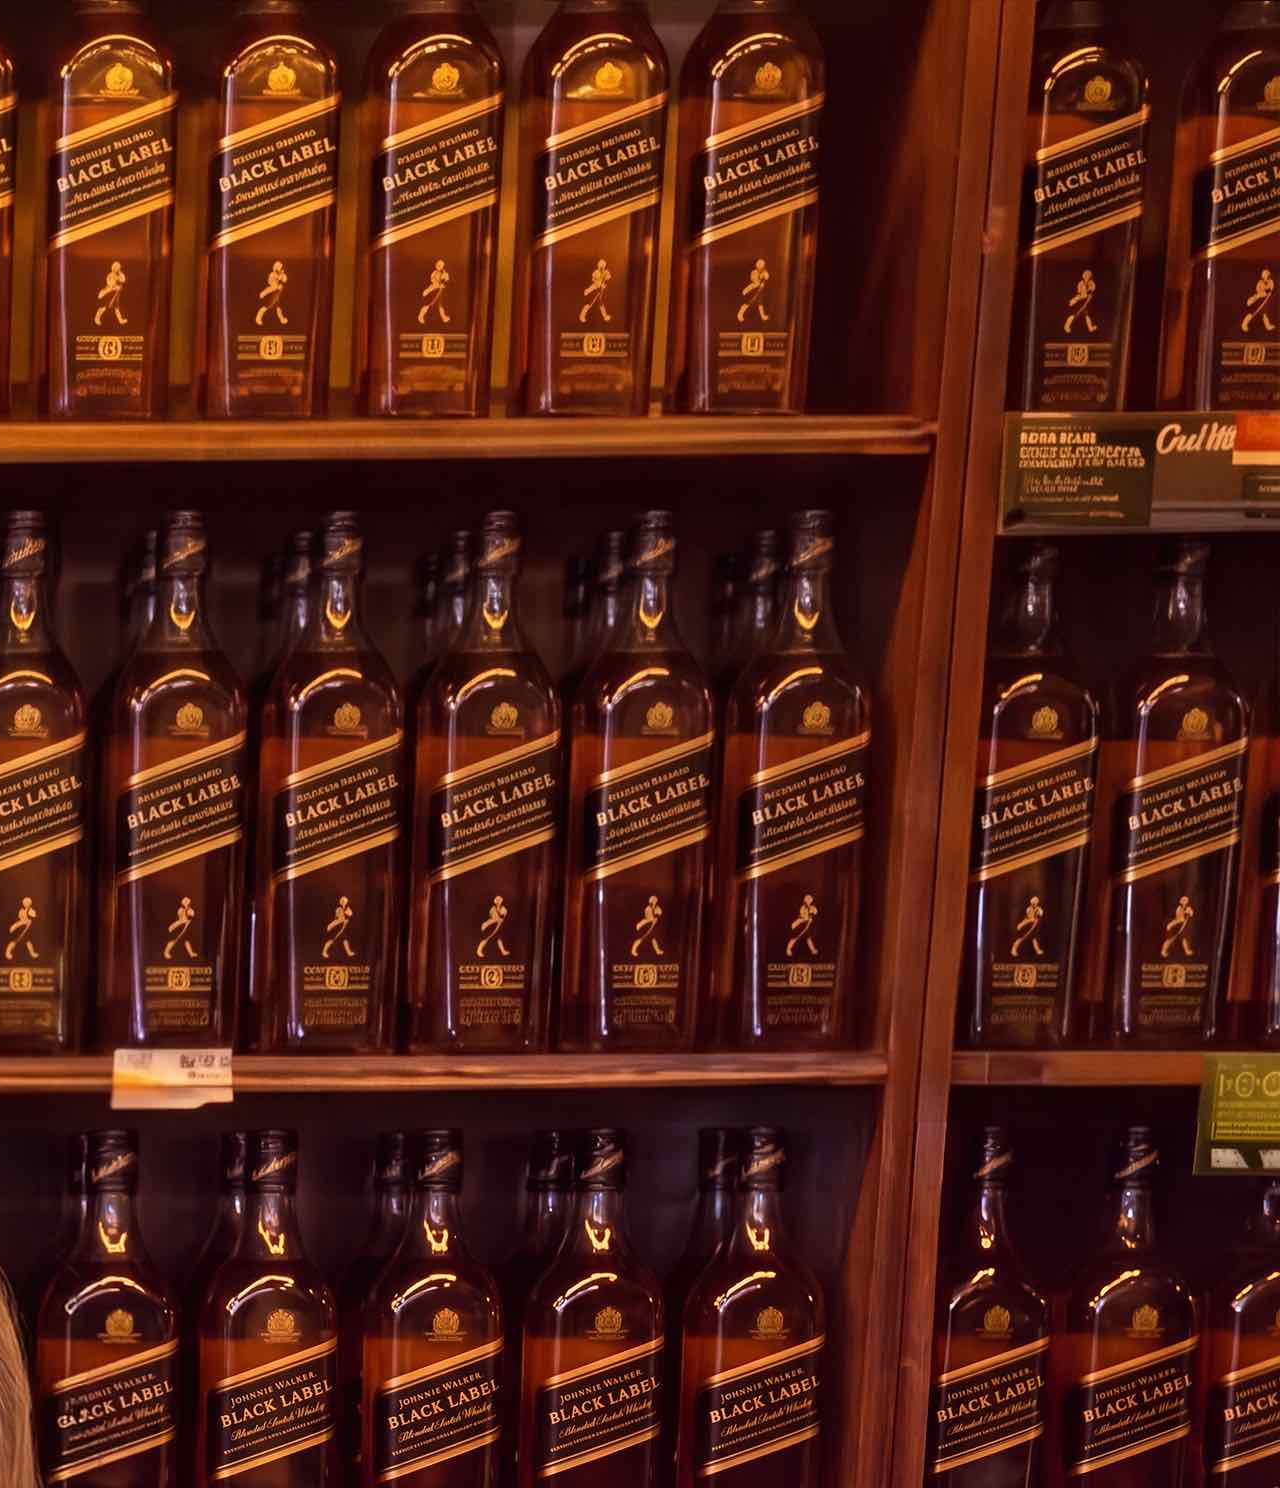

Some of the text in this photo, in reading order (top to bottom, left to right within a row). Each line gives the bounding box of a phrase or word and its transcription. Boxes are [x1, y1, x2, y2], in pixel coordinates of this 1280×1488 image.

[220, 1379, 333, 1429] BLACK LABEL
[387, 1379, 499, 1430] BLACK LABEL
[549, 1376, 660, 1425] BLACK LABEL
[709, 1375, 820, 1424] BLACK LABEL
[936, 1394, 992, 1423] BLACK
